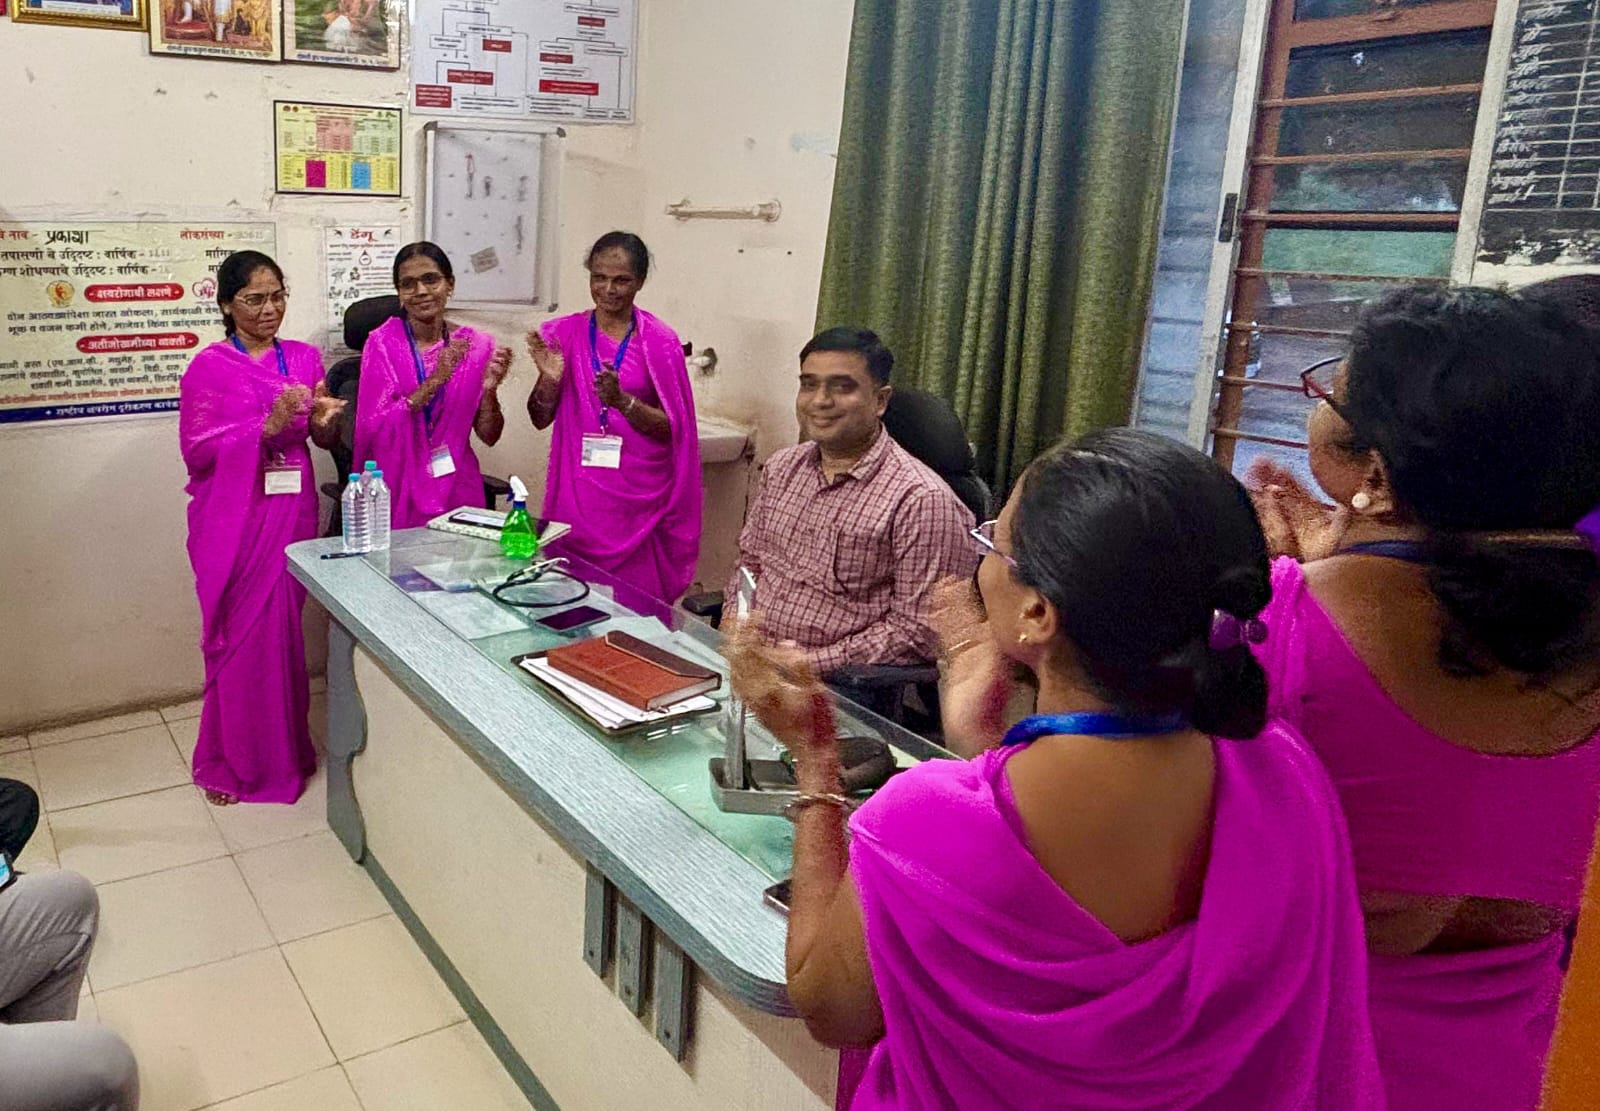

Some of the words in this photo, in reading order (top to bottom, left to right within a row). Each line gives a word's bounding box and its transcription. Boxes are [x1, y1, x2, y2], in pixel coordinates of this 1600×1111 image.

[9, 231, 29, 240] नाव
[180, 228, 225, 240] लोकसंख्या
[1, 248, 43, 260] तपासणी
[104, 247, 137, 259] वार्षिक
[117, 262, 149, 275] वार्षिक
